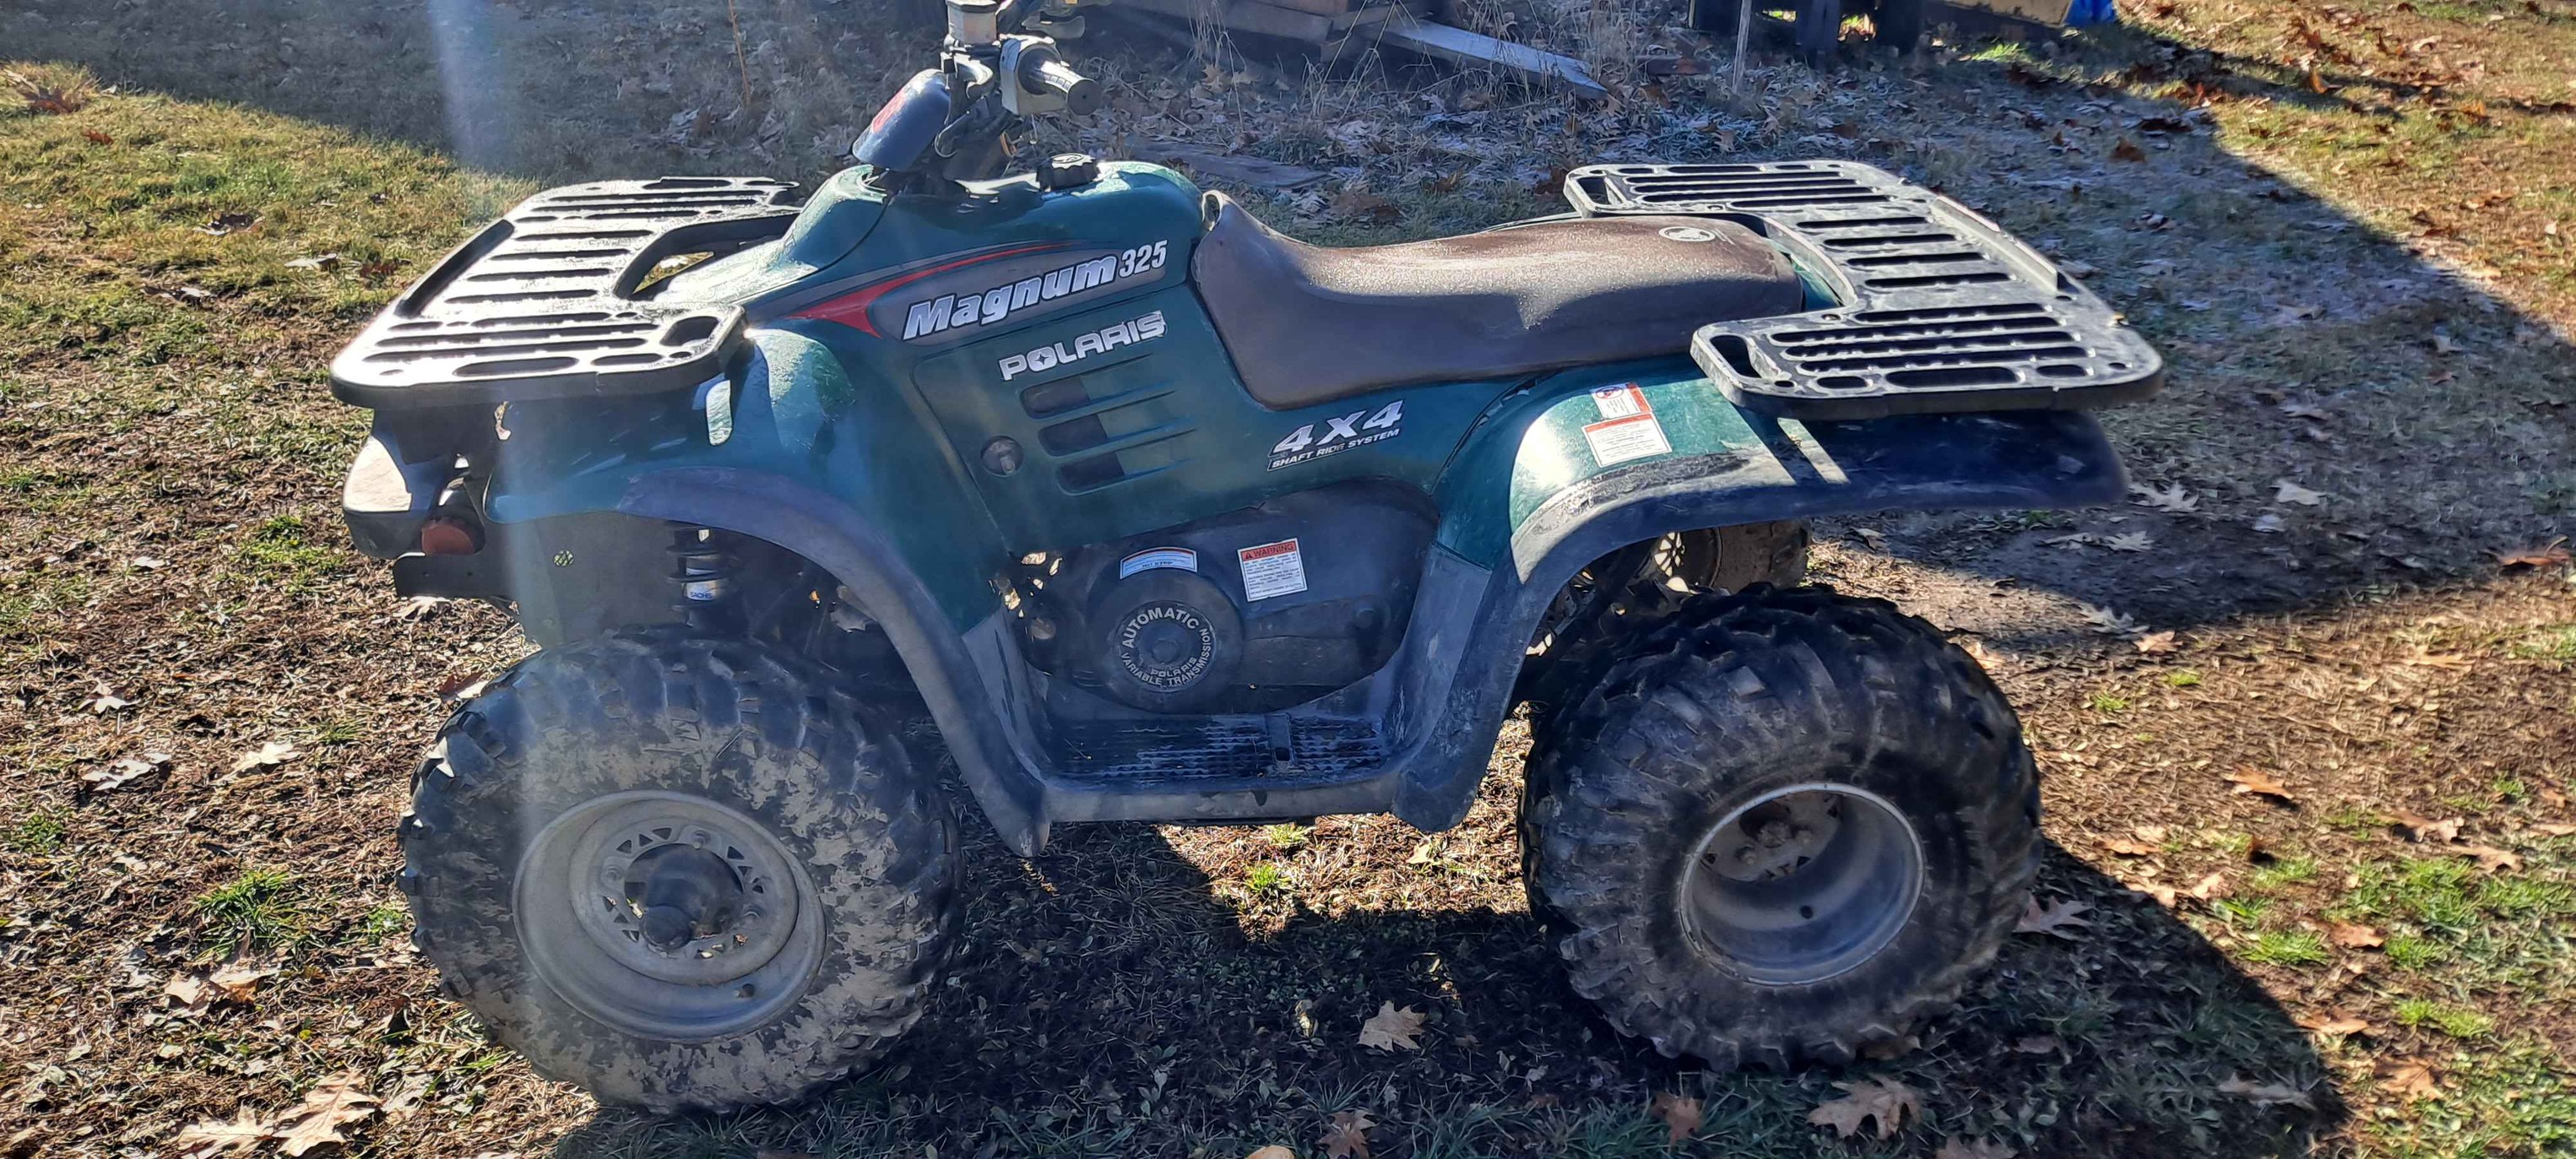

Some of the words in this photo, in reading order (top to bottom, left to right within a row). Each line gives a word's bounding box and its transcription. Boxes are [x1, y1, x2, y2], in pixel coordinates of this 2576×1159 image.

[902, 255, 1119, 340] Magnum
[1119, 240, 1169, 278] 325
[999, 311, 1168, 381] POLARIS
[1272, 451, 1315, 468] SHAFT
[1348, 428, 1401, 449] SYSTEM
[1253, 543, 1294, 557] WARNING
[1121, 607, 1199, 649] AUTOMATIC
[1121, 652, 1163, 685] VARIABLE
[1167, 628, 1212, 685] TRANSMISSION
[1150, 657, 1197, 678] POLARIS
